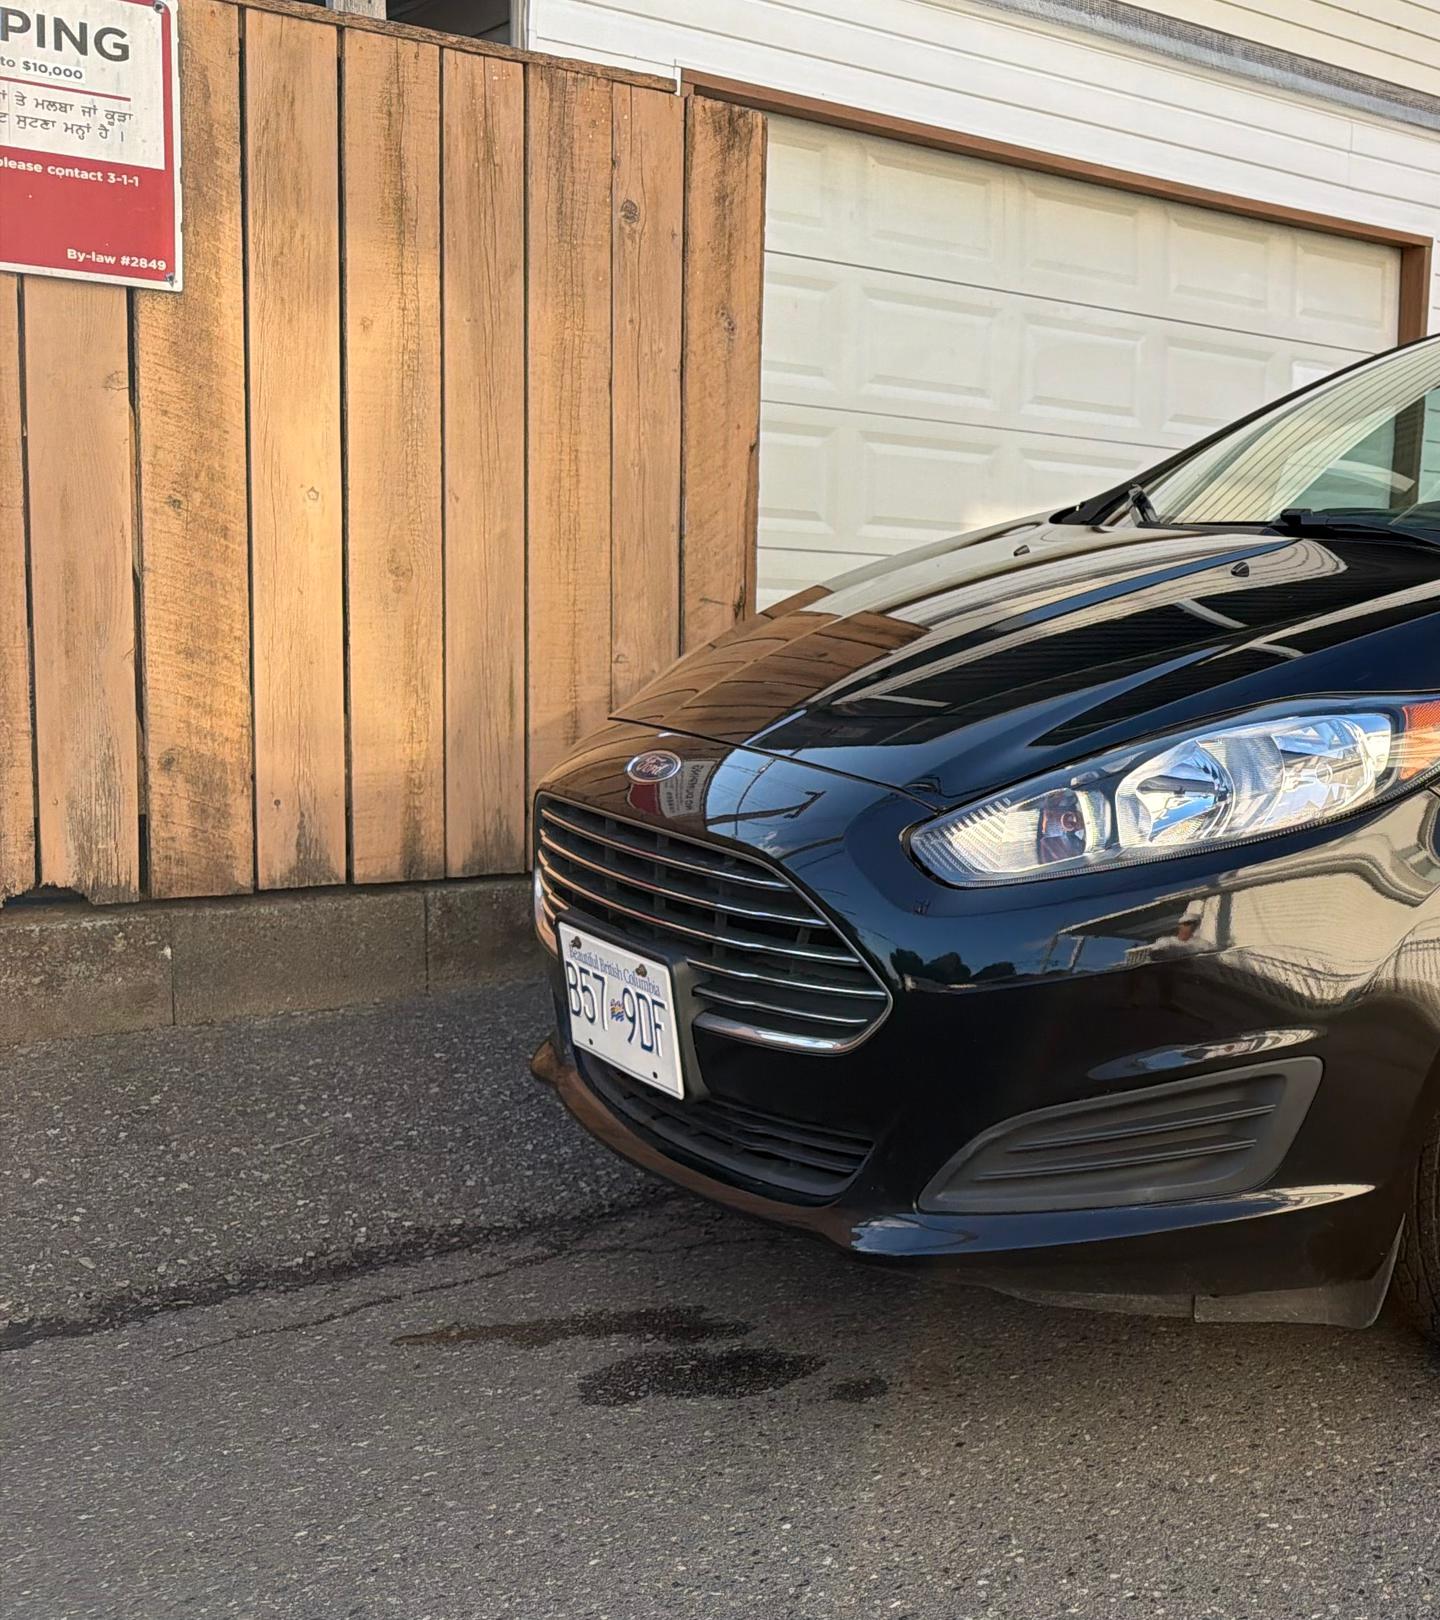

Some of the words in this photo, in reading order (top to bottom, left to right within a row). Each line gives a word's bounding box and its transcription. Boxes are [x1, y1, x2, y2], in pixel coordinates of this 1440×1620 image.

[22, 60, 83, 80] $10,000
[33, 98, 74, 114] ਮਲਬਾ
[47, 165, 103, 182] contact
[107, 172, 139, 187] 3-1-1
[67, 248, 116, 265] By-law
[120, 255, 166, 271] #2849
[636, 756, 670, 775] Ford
[600, 958, 623, 980] British
[624, 968, 660, 995] Columbia
[622, 987, 668, 1057] 9DF
